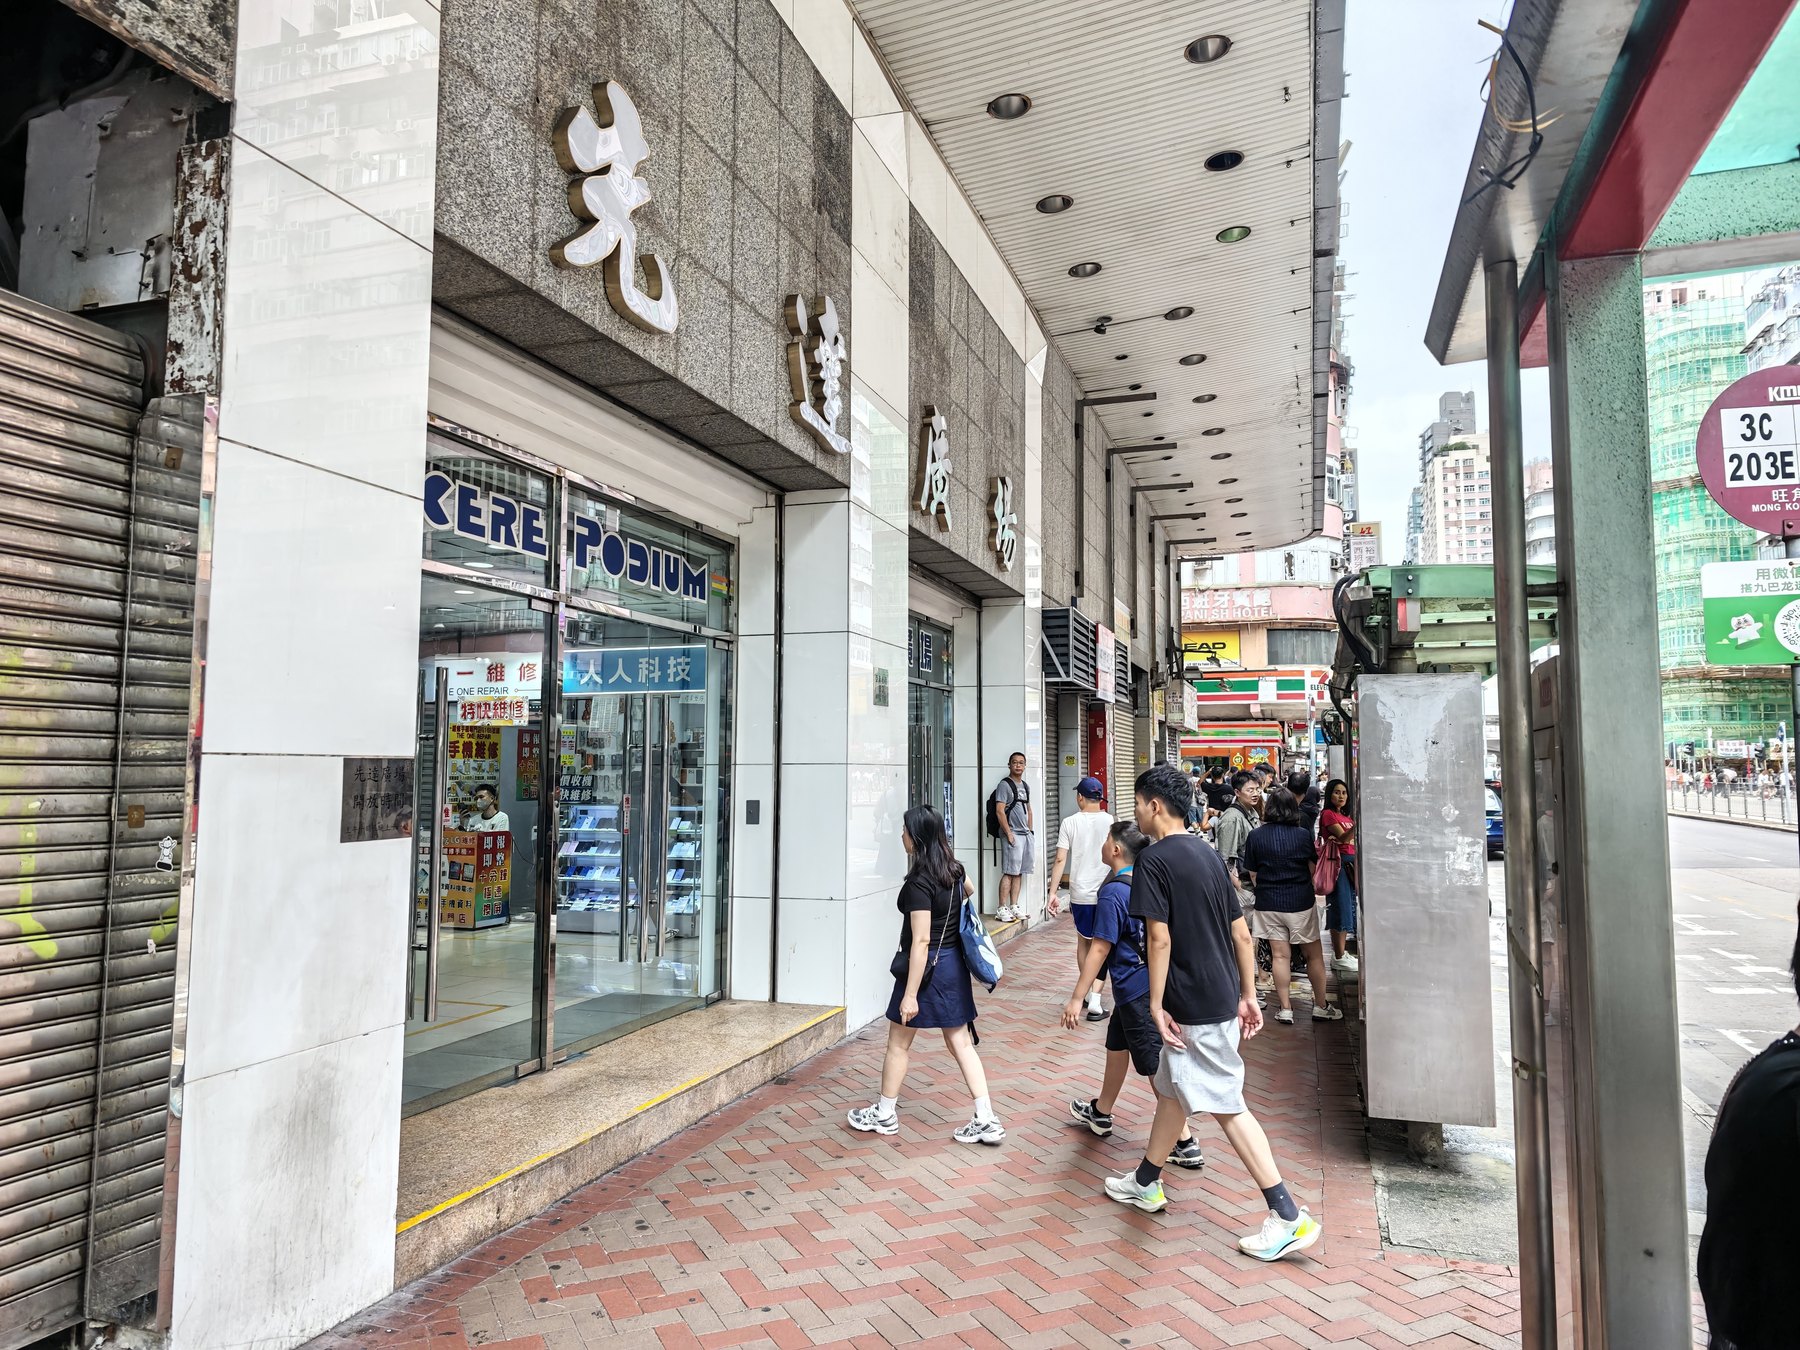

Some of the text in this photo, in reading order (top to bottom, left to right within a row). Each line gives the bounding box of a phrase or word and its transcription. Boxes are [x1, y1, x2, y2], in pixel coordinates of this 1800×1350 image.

[1740, 413, 1774, 442] 3C
[1728, 450, 1796, 482] 203E
[1751, 503, 1782, 513] MONG
[574, 511, 708, 604] PODIUM
[1232, 606, 1275, 619] HOTEL
[456, 662, 537, 682] 一維修
[580, 656, 691, 685] 人人科技
[456, 687, 475, 696] ONE
[477, 687, 509, 696] REPAIR
[461, 701, 523, 720] 特快維修
[449, 740, 498, 759] 手機維修
